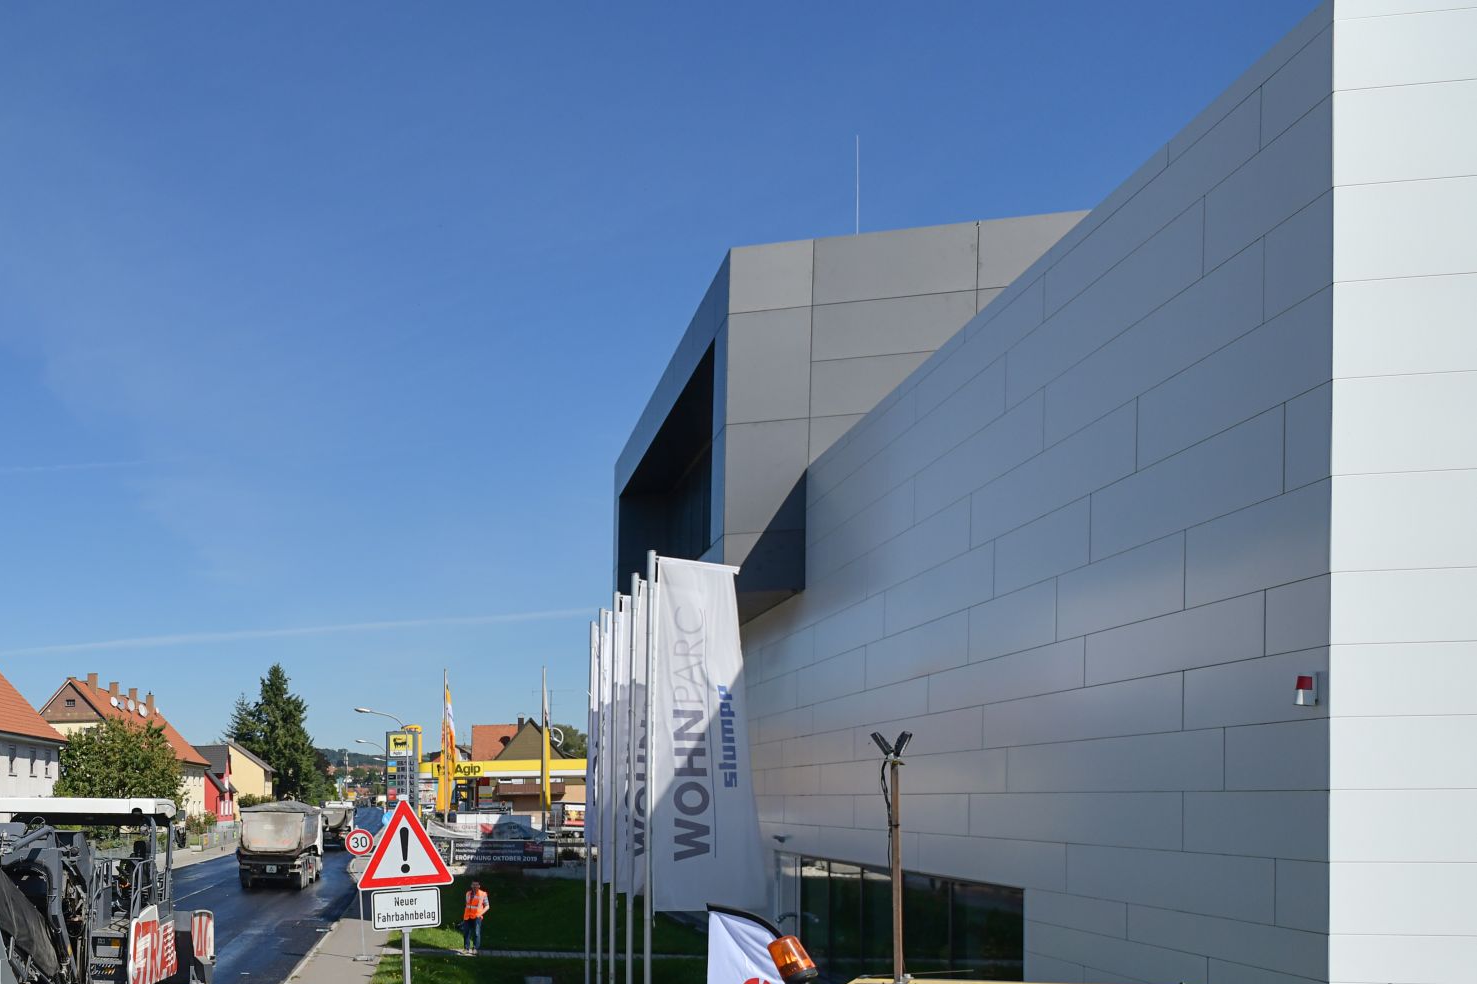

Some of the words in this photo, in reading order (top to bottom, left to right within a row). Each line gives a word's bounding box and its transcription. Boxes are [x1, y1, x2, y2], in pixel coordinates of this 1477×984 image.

[673, 606, 711, 862] WOHNPARC
[718, 684, 738, 788] stumpp
[455, 764, 481, 776] Agip
[352, 837, 368, 848] 30
[455, 853, 491, 861] ERÖFFNUNG
[394, 897, 418, 907] Neuer
[377, 910, 436, 923] Fahrbahnbelag
